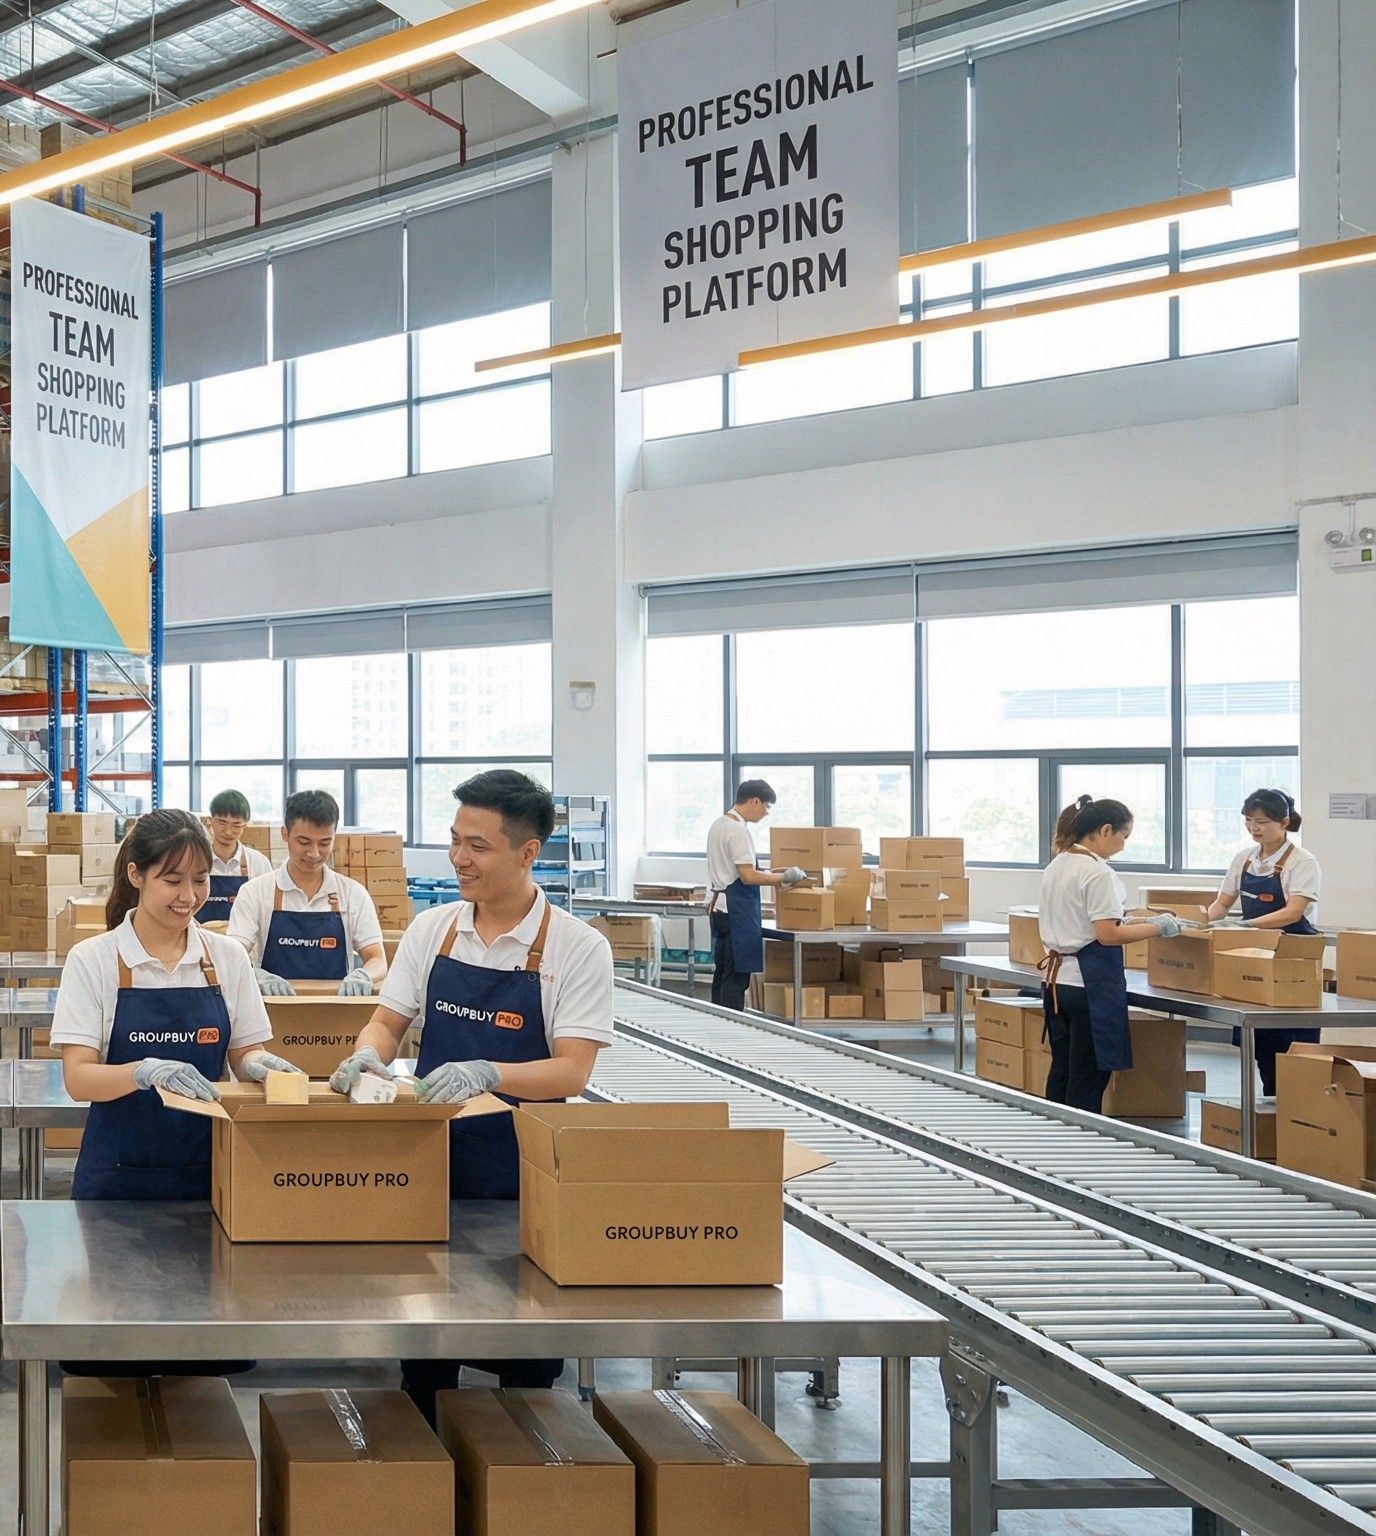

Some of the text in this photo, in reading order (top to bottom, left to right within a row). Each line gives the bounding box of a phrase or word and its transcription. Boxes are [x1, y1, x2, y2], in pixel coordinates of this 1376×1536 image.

[638, 54, 874, 154] PROFESSIONAL
[685, 123, 818, 209] TEAM
[663, 192, 844, 270] SHOPPING
[23, 261, 139, 321] PROFESSIONAL
[662, 247, 847, 324] PLATFORM
[48, 310, 115, 367] TEAM
[37, 362, 125, 410] SHOPPING
[36, 402, 126, 450] PLATFORM
[128, 1031, 196, 1043] GROUPBUY
[283, 1036, 343, 1046] GROUPBUY
[273, 1172, 409, 1187] GROUPBUY PRO
[605, 1226, 739, 1240] GROUPBUY PRO
